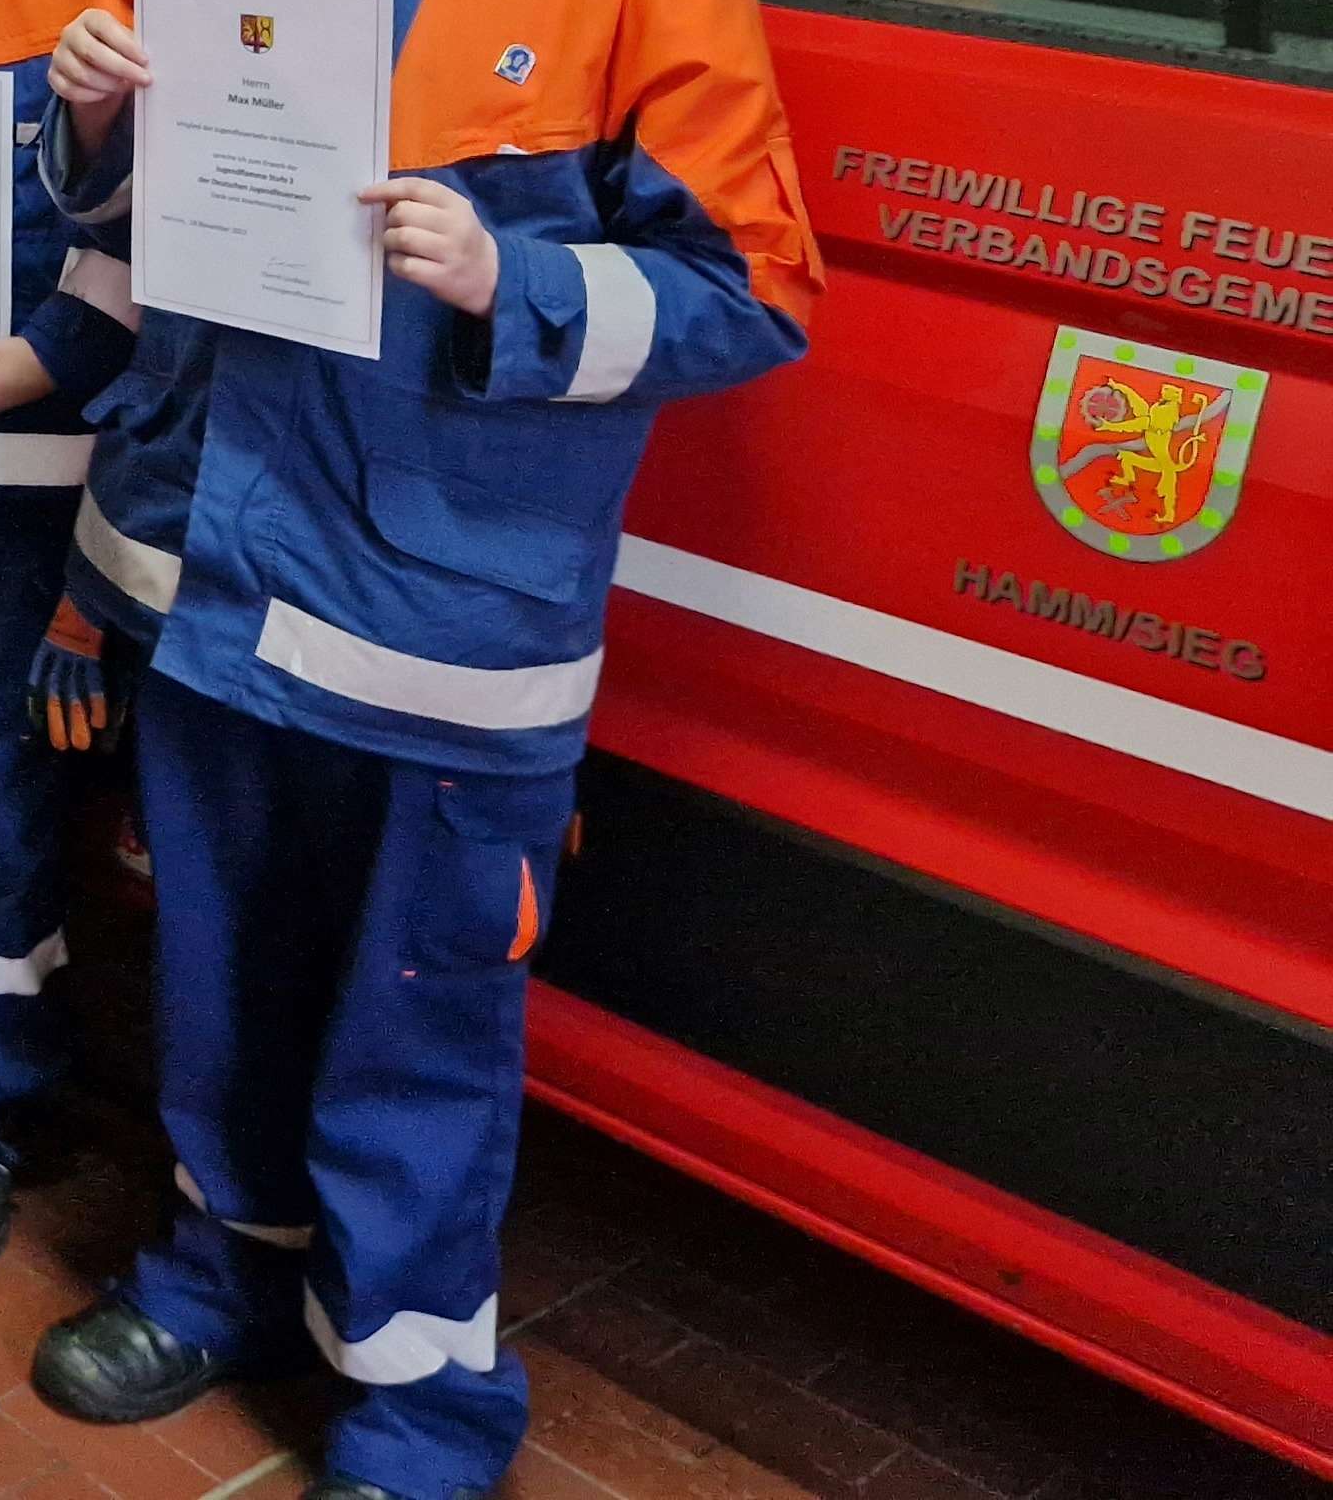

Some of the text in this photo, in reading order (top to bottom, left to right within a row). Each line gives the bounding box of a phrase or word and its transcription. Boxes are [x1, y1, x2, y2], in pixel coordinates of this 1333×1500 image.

[227, 93, 285, 110] Max Müller
[242, 76, 271, 89] Herrn
[833, 145, 1165, 243] FREIWILLIGE
[953, 558, 1266, 681] HAMM/SIEG
